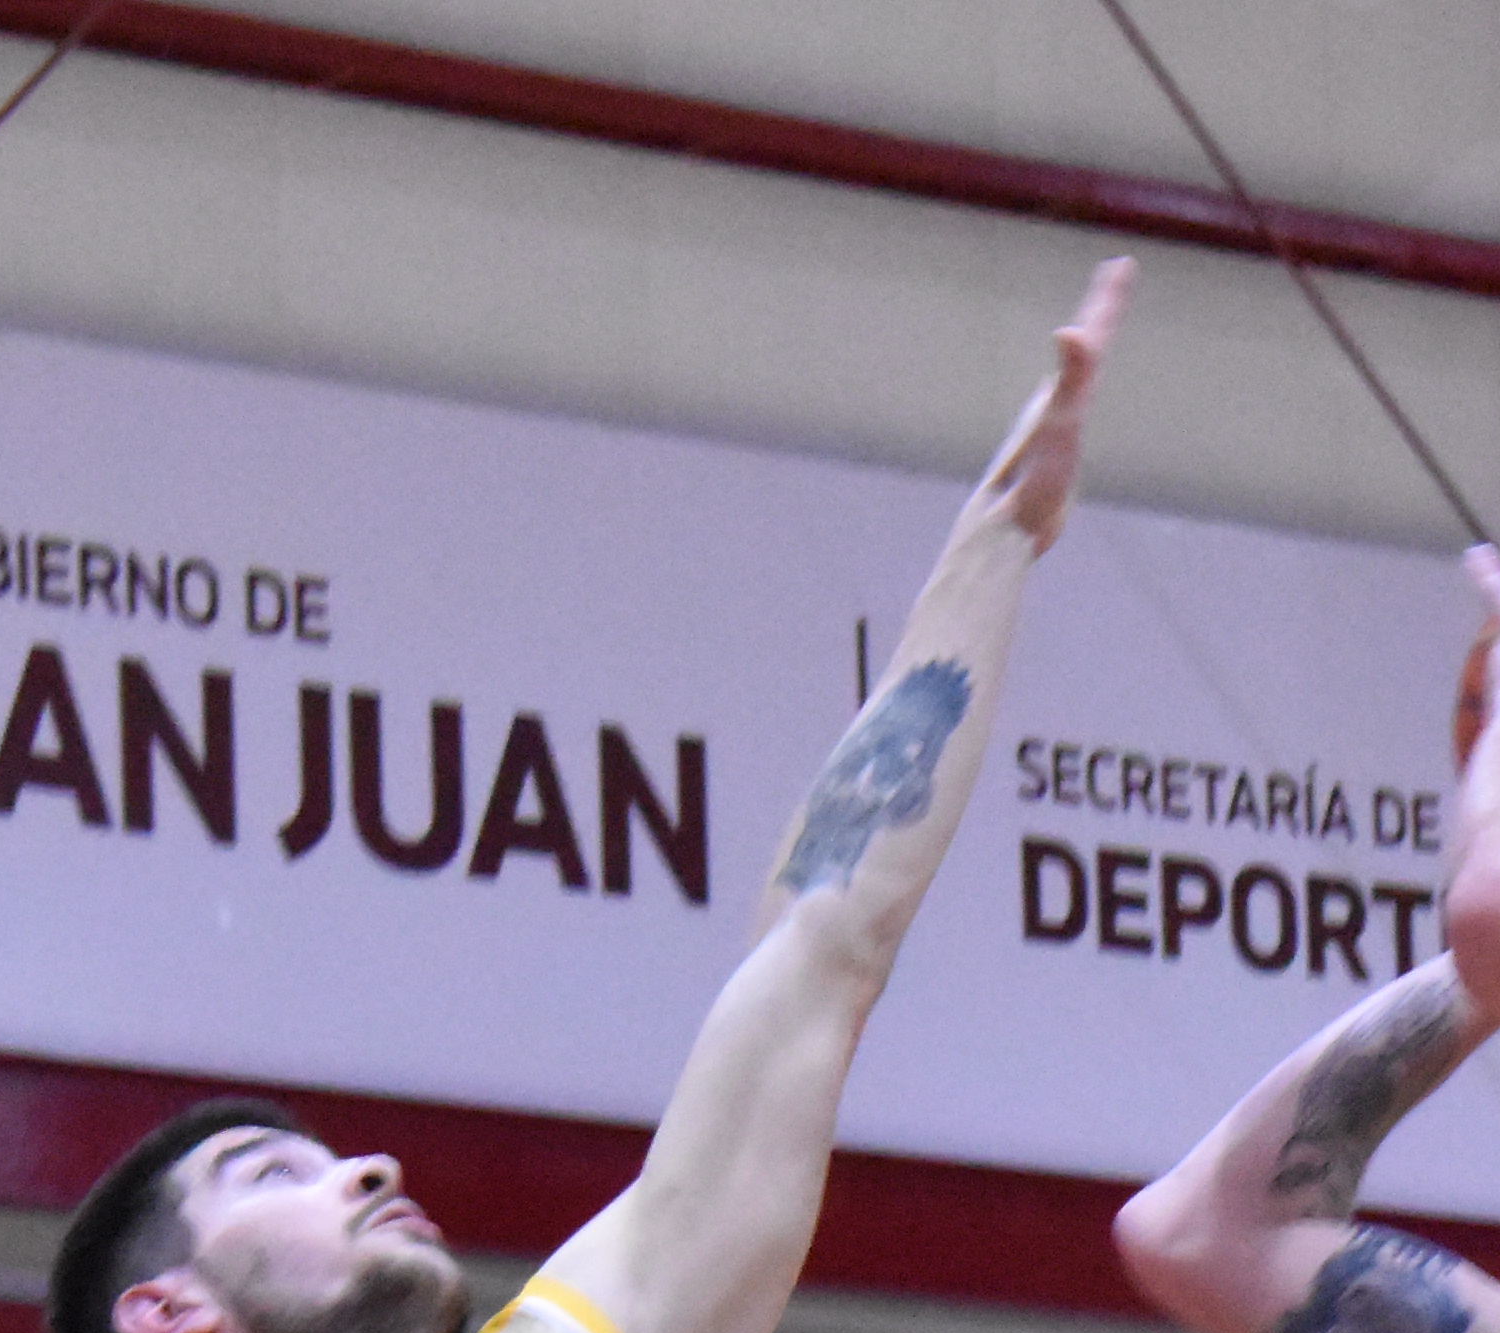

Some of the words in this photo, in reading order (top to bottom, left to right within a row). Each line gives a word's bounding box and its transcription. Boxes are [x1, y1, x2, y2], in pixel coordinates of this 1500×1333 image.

[243, 569, 332, 643] DE
[277, 679, 709, 907] JUAN
[1016, 735, 1356, 847] SECRETARÍA
[1372, 785, 1442, 852] DE
[1020, 835, 1454, 984] DEPORT
